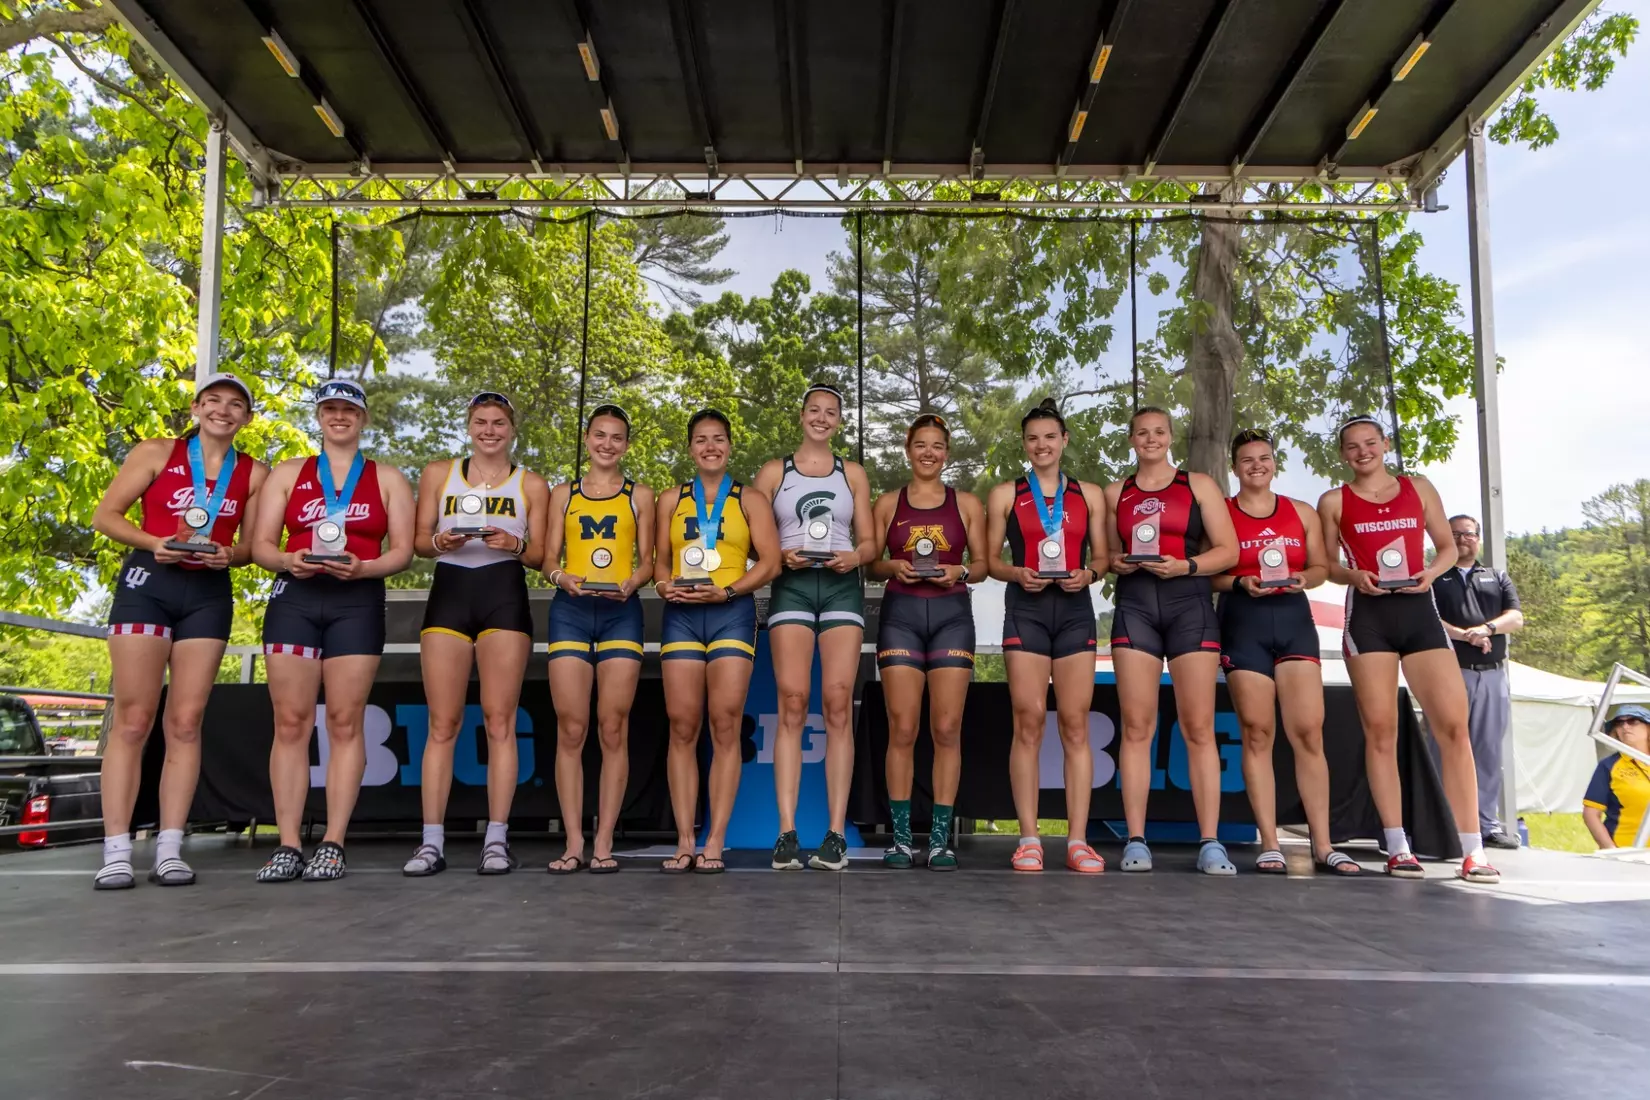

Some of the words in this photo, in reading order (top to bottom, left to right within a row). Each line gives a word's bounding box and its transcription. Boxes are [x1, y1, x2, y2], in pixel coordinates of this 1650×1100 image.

[579, 515, 617, 540] M
[1354, 518, 1418, 533] WISCONSIN
[1241, 537, 1301, 549] UTGERS
